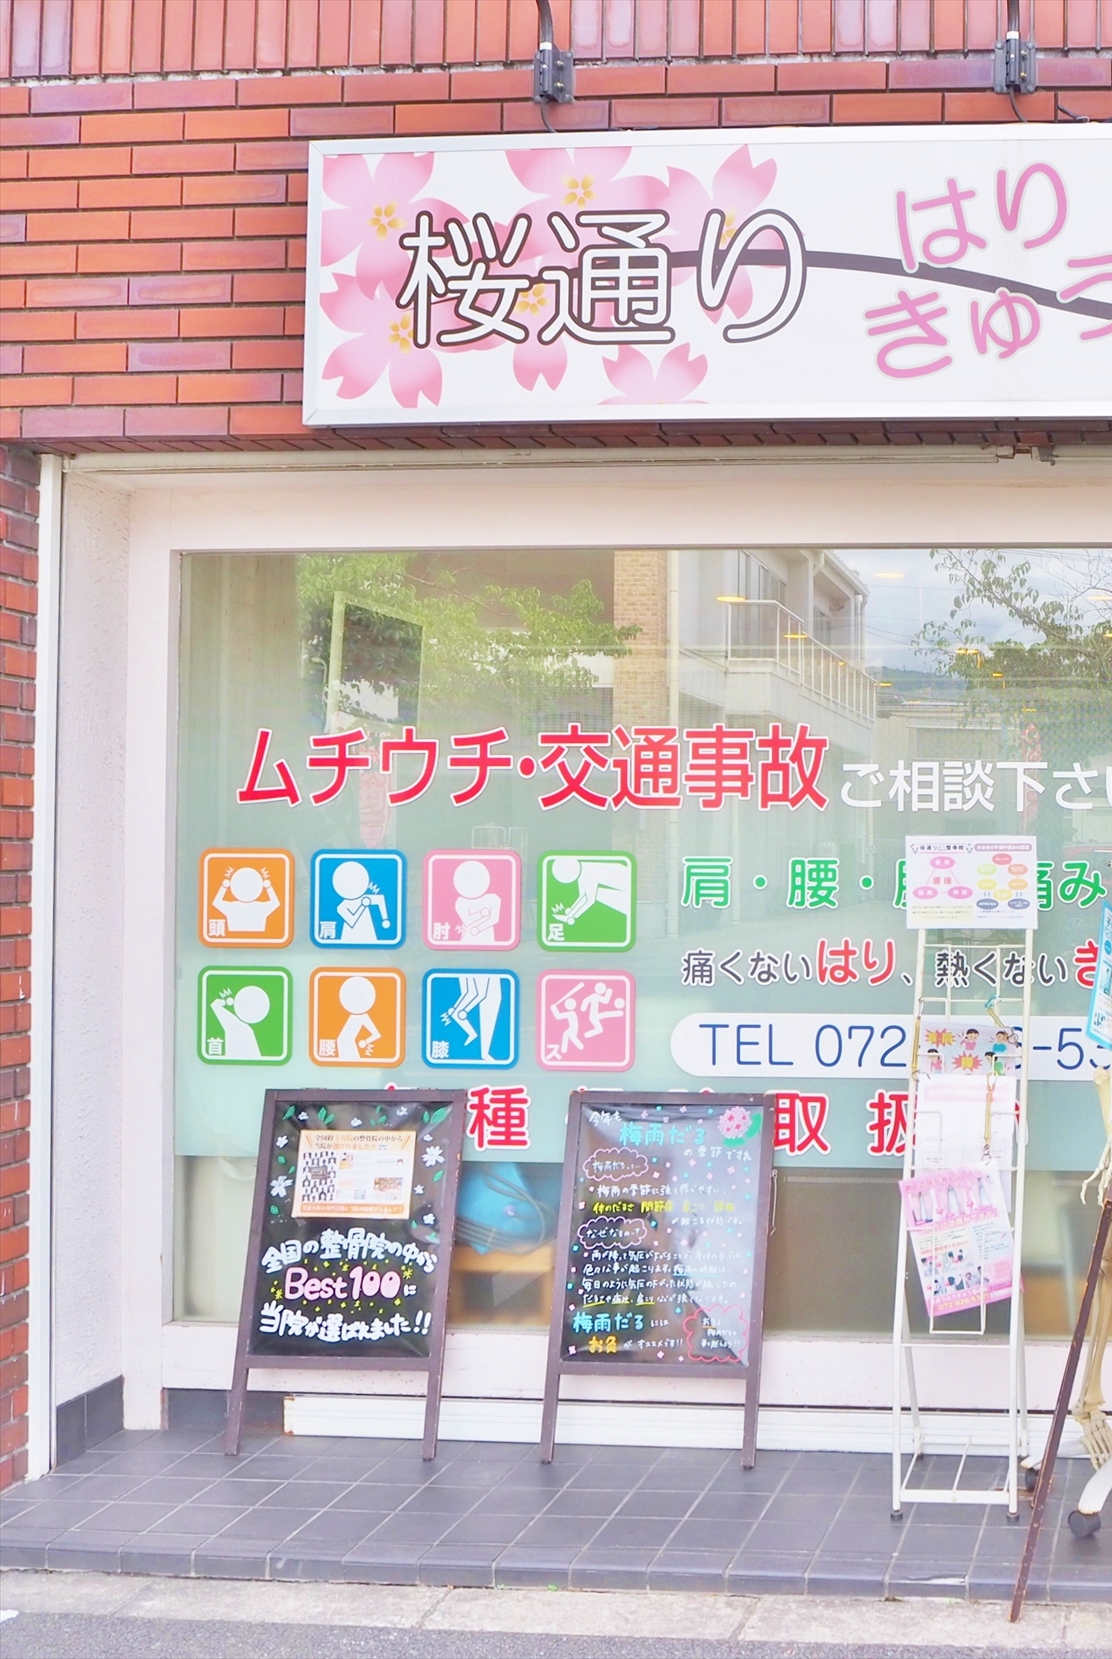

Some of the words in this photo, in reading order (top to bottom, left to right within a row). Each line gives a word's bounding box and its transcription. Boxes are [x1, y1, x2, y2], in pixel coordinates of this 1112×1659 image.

[896, 160, 1070, 272] はり
[398, 208, 807, 348] 桜通り
[207, 918, 227, 938] 頭
[318, 920, 337, 940] 肩
[431, 921, 451, 941] 肘
[546, 923, 566, 943] 足
[206, 1036, 226, 1056] 首
[318, 1037, 337, 1058] 腰
[431, 1038, 451, 1059] 膝
[544, 1040, 563, 1061] ス
[698, 1022, 794, 1068] TEL
[618, 1121, 707, 1147] 梅雨だる
[261, 1227, 438, 1274] 全国の整骨院の中から
[572, 1312, 645, 1334] 梅雨だる
